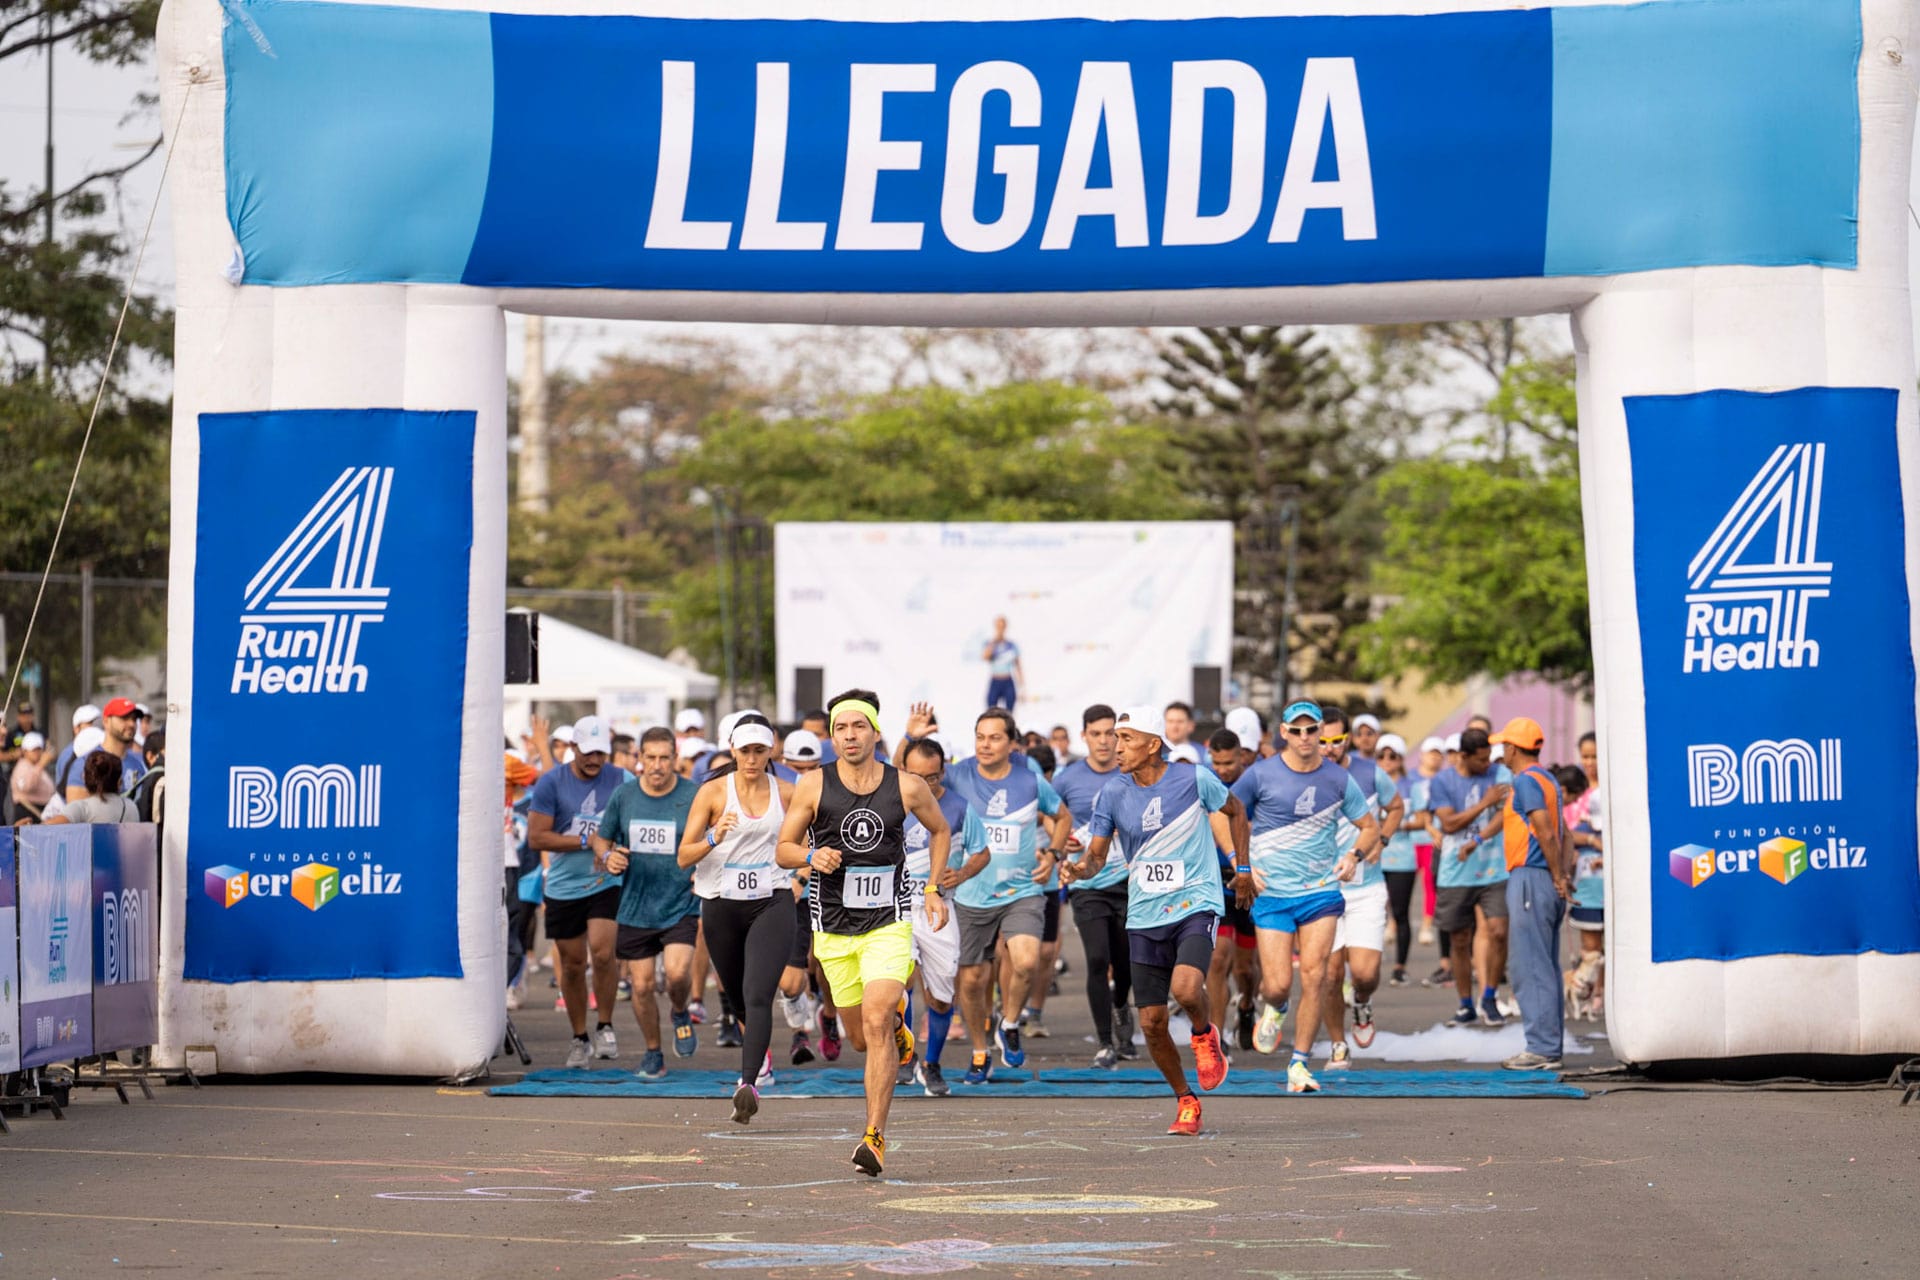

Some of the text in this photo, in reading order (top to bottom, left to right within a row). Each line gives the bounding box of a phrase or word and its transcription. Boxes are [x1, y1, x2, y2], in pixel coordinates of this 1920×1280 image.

[643, 57, 1379, 253] LLEGADA
[1685, 442, 1833, 602] 4
[240, 467, 394, 622] 4
[1686, 603, 1769, 637] Run
[237, 624, 319, 658] Run
[1683, 636, 1821, 674] Health
[231, 658, 369, 694] Health
[1687, 738, 1843, 807] BMI
[228, 763, 382, 829] BMI
[579, 821, 600, 836] 26
[639, 827, 666, 844] 286
[855, 822, 870, 838] A
[1714, 824, 1837, 839] FUNDACIÓN
[249, 851, 372, 863] FUNDACIÓN
[1145, 864, 1174, 882] 262
[737, 872, 758, 890] 86
[854, 876, 881, 896] 110
[103, 888, 150, 986] BMI
